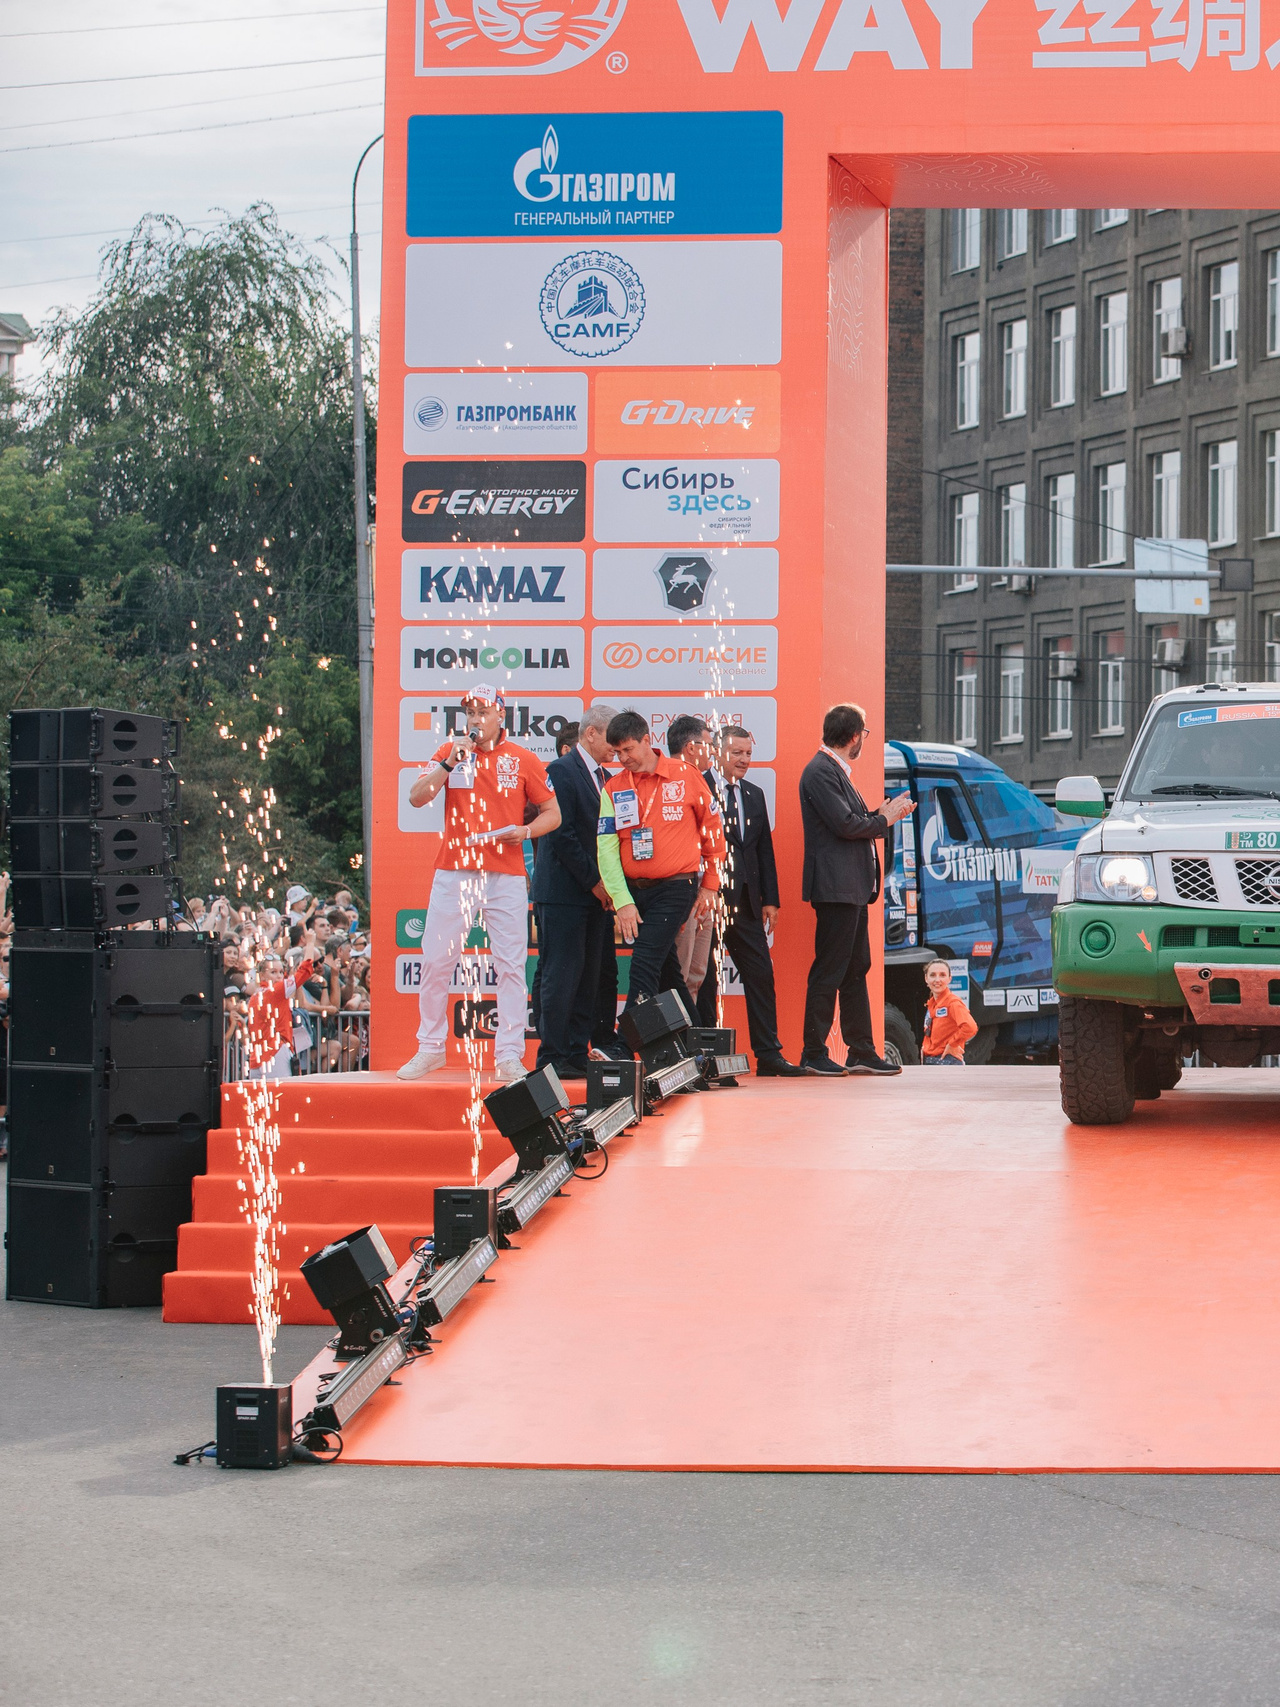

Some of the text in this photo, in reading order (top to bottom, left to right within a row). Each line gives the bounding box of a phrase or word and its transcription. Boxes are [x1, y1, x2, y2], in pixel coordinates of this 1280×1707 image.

[677, 0, 988, 73] WAY
[562, 172, 675, 202] ГАЗПРОМ
[514, 209, 675, 226] ГЕНЕРАЛЬНЫЙ ПАРТНЕР
[554, 322, 630, 338] CAMF
[457, 405, 577, 422] ГАЗПРОМБАНК
[622, 466, 735, 495] Сибирь
[667, 494, 752, 515] здесь
[420, 566, 566, 603] KAMAZ
[414, 647, 570, 670] MONGOLIA
[646, 647, 767, 664] СОГЛАСИЕ
[1221, 712, 1258, 720] RUSSIA
[662, 806, 684, 814] SILK
[662, 813, 684, 821] WAY
[1257, 832, 1276, 848] 80
[950, 847, 1018, 881] ГАЗПРОМ
